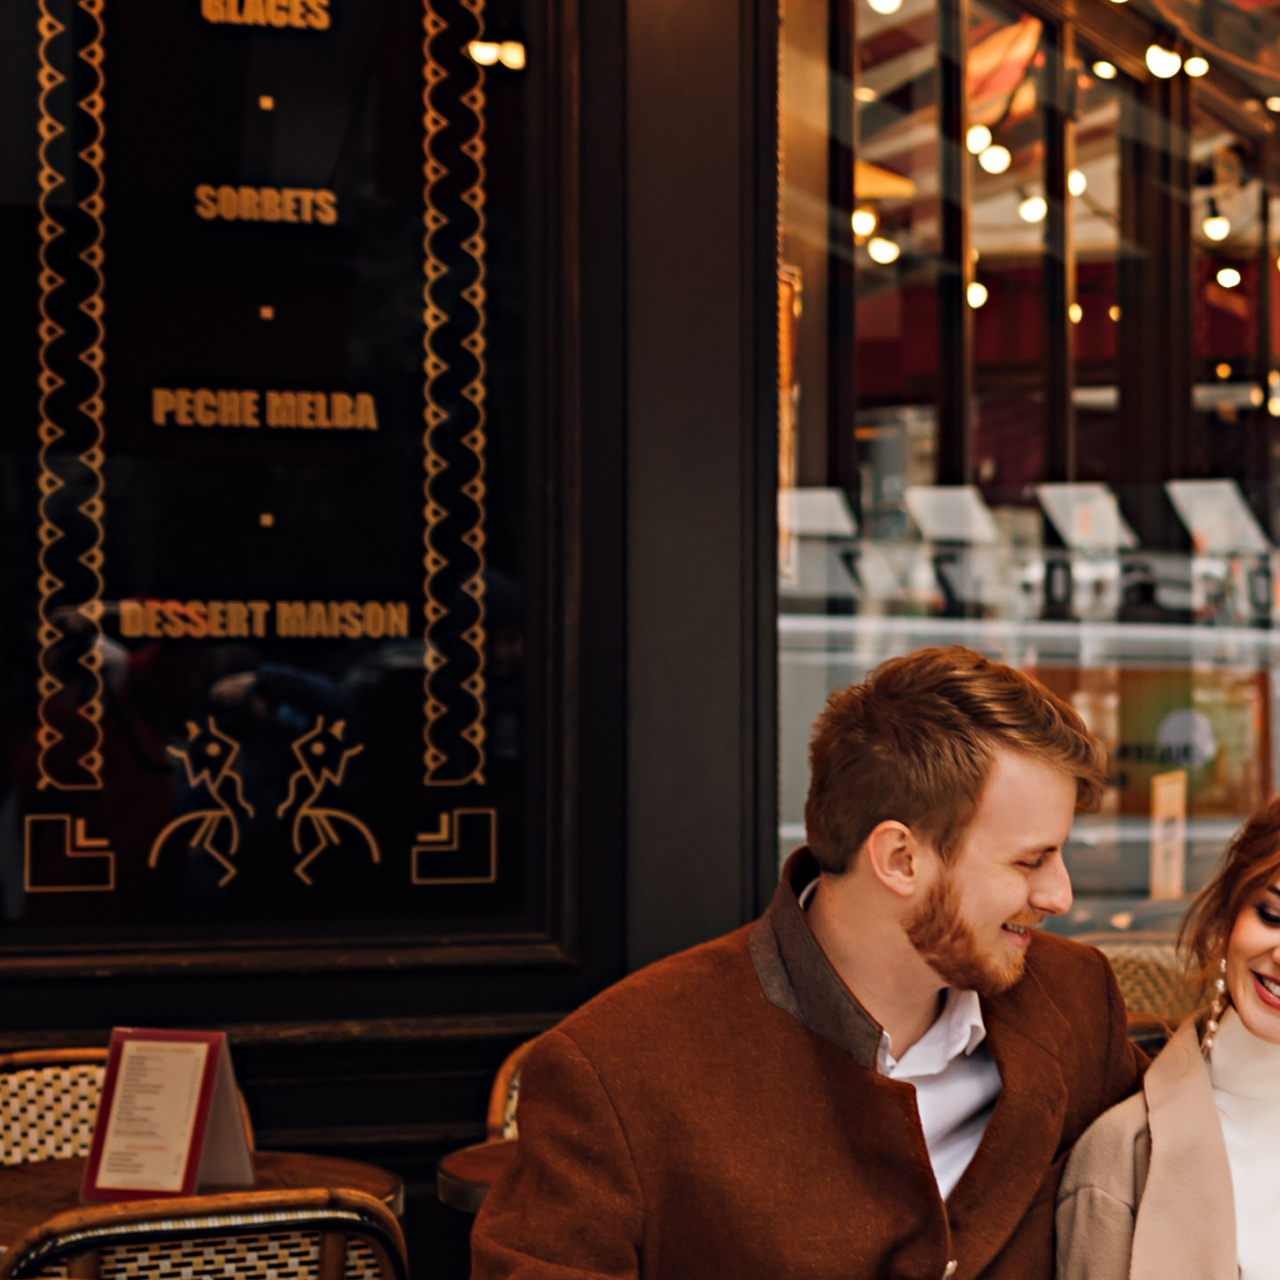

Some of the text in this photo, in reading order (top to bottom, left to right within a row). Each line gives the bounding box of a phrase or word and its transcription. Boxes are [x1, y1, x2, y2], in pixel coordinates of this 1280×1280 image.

[195, 184, 337, 226] SORBETS
[152, 388, 379, 431] PECHE MELBA
[119, 598, 409, 639] DESSERT MAISON
